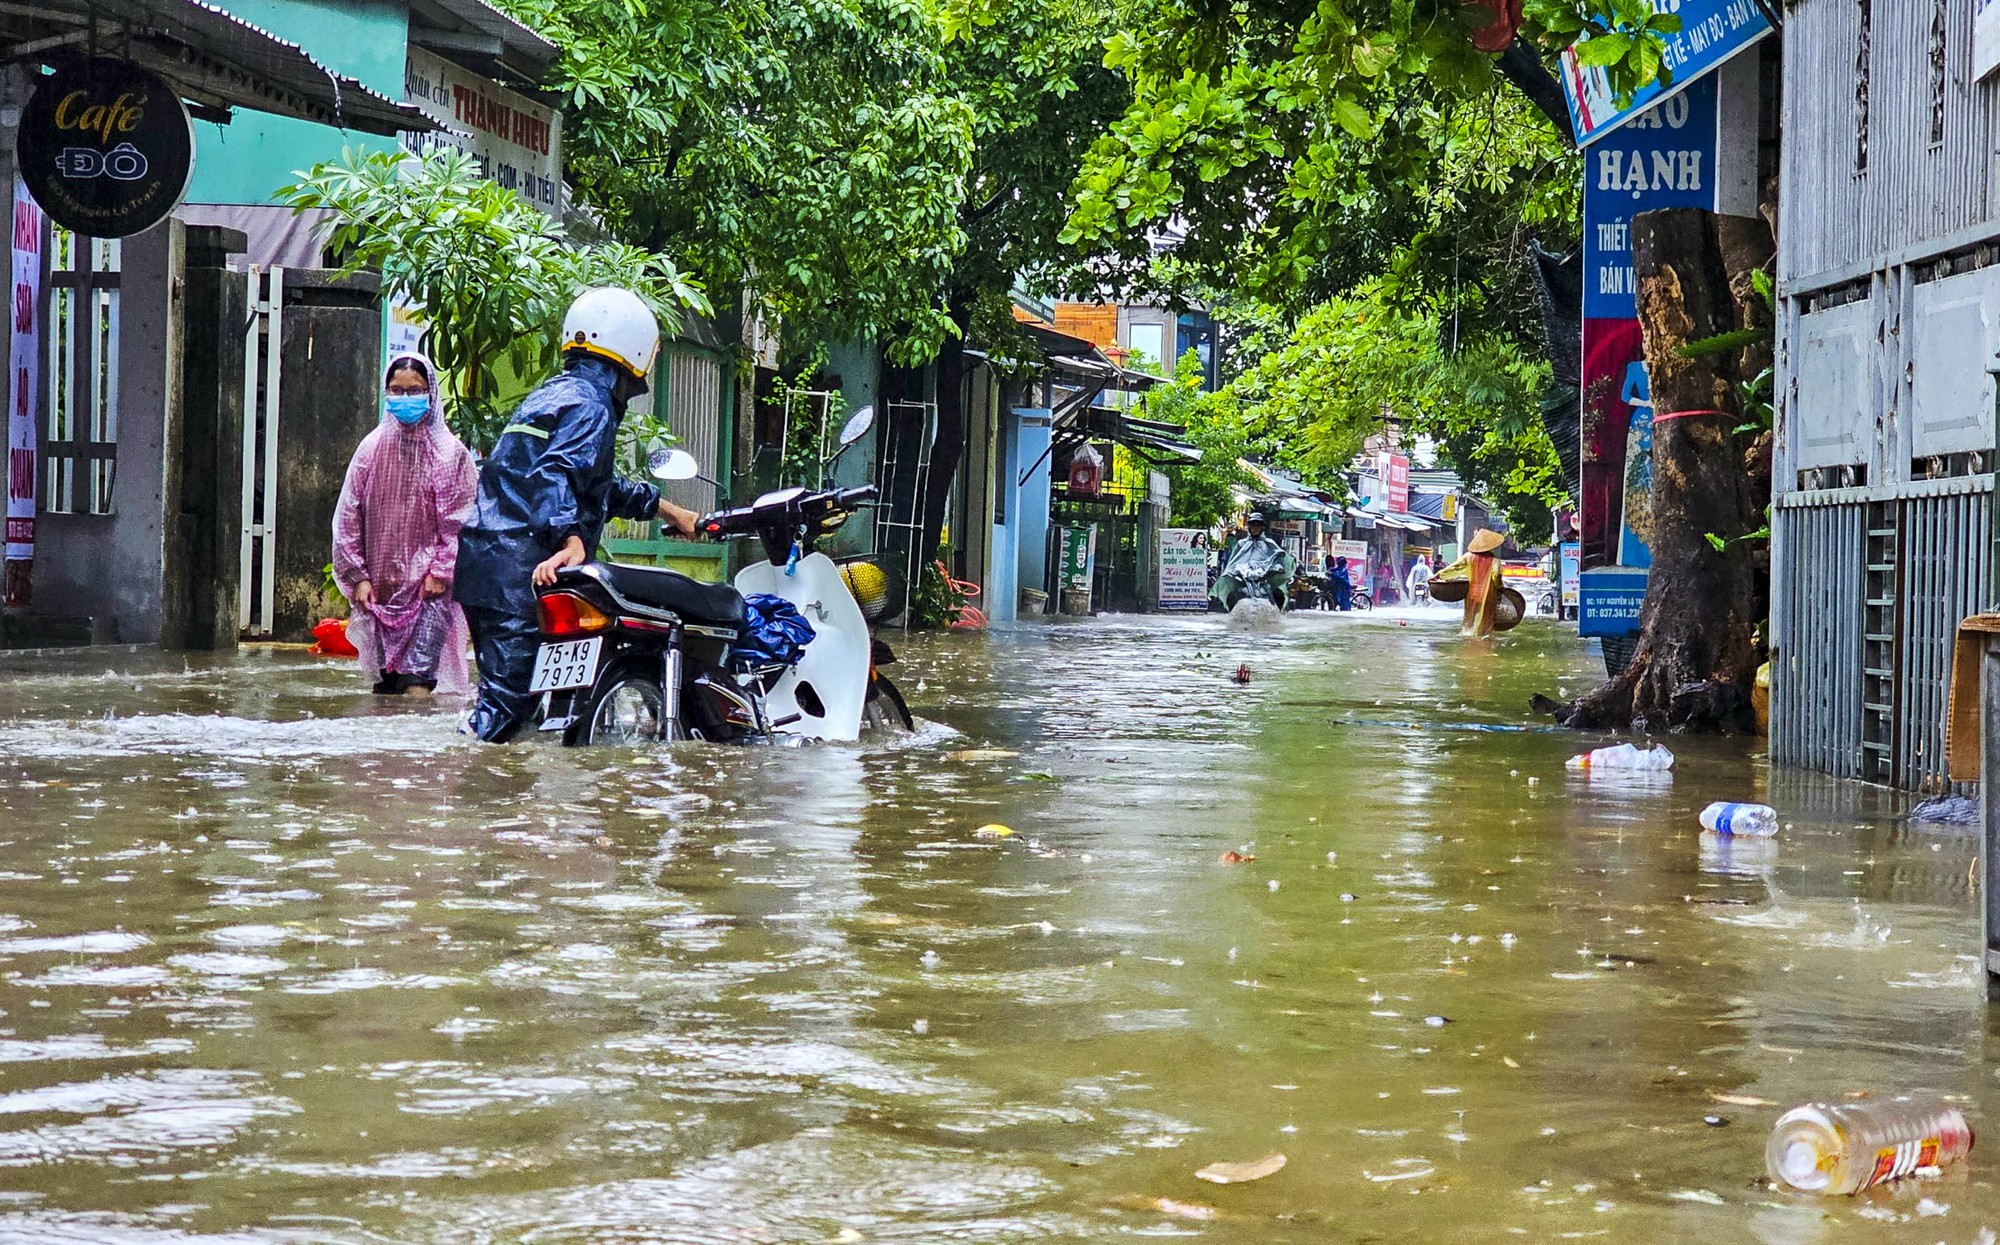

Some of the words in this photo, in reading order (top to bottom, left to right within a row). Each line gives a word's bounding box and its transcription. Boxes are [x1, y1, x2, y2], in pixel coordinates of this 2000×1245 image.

[1688, 20, 1711, 55] MAY
[1708, 13, 1724, 42] ĐO
[55, 89, 149, 144] Café
[453, 83, 511, 141] THÀNH
[512, 108, 550, 159] HIỆU
[55, 142, 148, 181] ĐÔ
[1597, 150, 1702, 200] HẠNH
[497, 161, 518, 191] CƠM
[537, 172, 556, 206] TIẾU
[1598, 216, 1627, 252] THIẾT
[1599, 260, 1623, 294] BÁN
[545, 641, 590, 666] 75-K9
[538, 664, 586, 689] 7973
